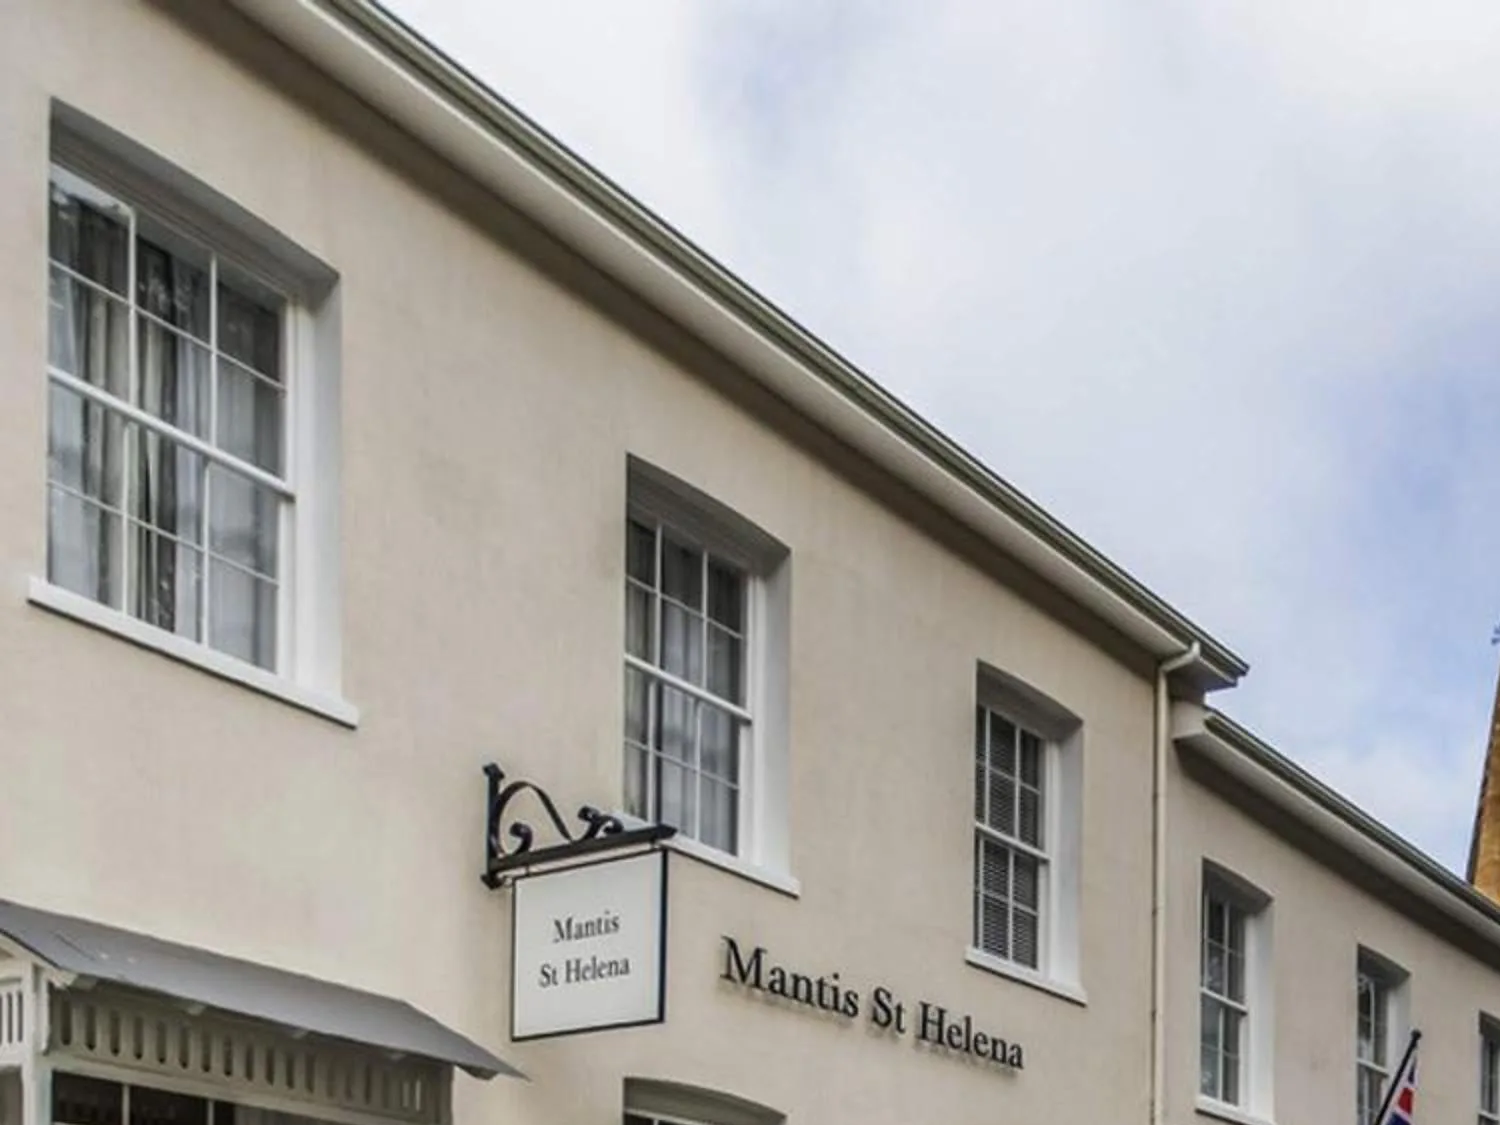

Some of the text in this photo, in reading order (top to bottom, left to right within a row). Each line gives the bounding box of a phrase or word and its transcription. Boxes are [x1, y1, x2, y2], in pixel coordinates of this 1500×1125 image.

[553, 909, 620, 944] Mantis
[538, 955, 631, 989] St Helena
[720, 935, 1025, 1070] Mantis St Helena
